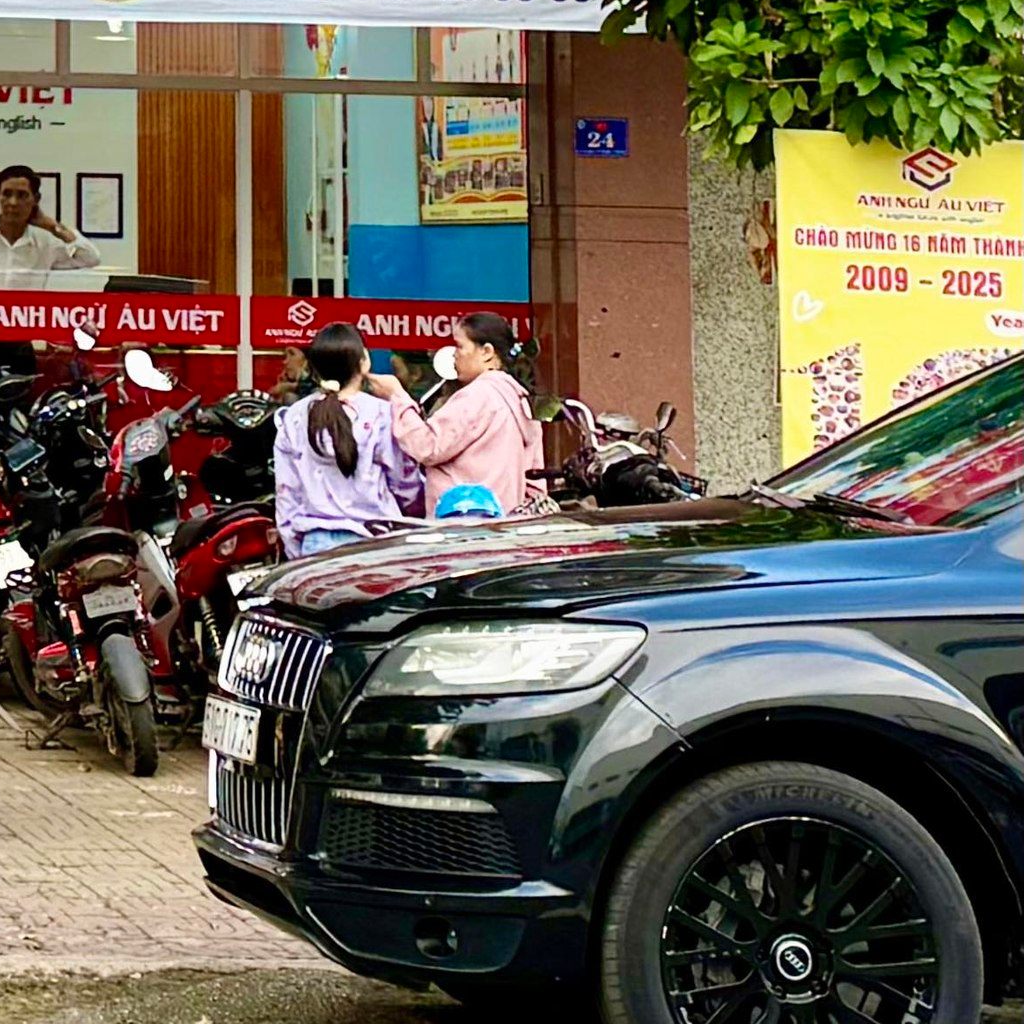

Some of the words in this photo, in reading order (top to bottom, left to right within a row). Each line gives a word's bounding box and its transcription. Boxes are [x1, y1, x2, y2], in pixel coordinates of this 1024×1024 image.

[587, 131, 615, 148] 24
[857, 195, 893, 207] ANH
[794, 225, 839, 247] CHÀO
[903, 235, 921, 252] 16
[928, 234, 967, 255] NĂM
[846, 264, 909, 293] 2009
[942, 269, 1003, 298] 2025
[117, 303, 156, 331] ÂU
[162, 304, 224, 335] VIỆT
[357, 314, 409, 337] ANH
